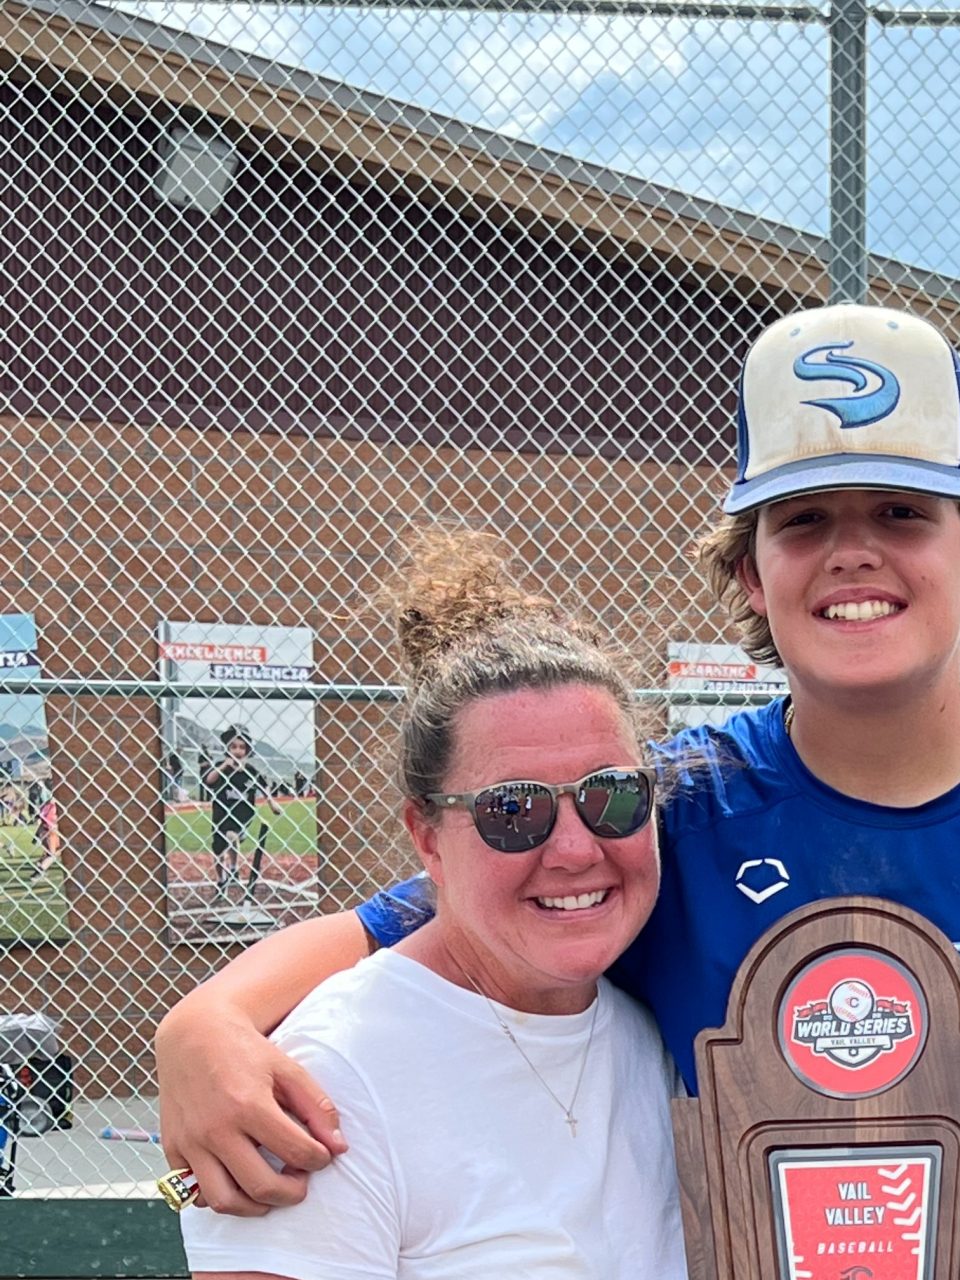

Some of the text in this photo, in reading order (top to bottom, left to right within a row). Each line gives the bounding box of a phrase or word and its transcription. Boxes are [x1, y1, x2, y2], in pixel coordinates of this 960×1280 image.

[165, 645, 263, 661] EXCELLENCE
[215, 665, 309, 681] EXCELENCIA
[797, 1017, 908, 1038] WORLD SERIES
[850, 1037, 877, 1045] VALLEY
[837, 1182, 872, 1201] VAIL
[825, 1206, 886, 1226] VALLEY
[817, 1241, 894, 1255] BASEBALL
